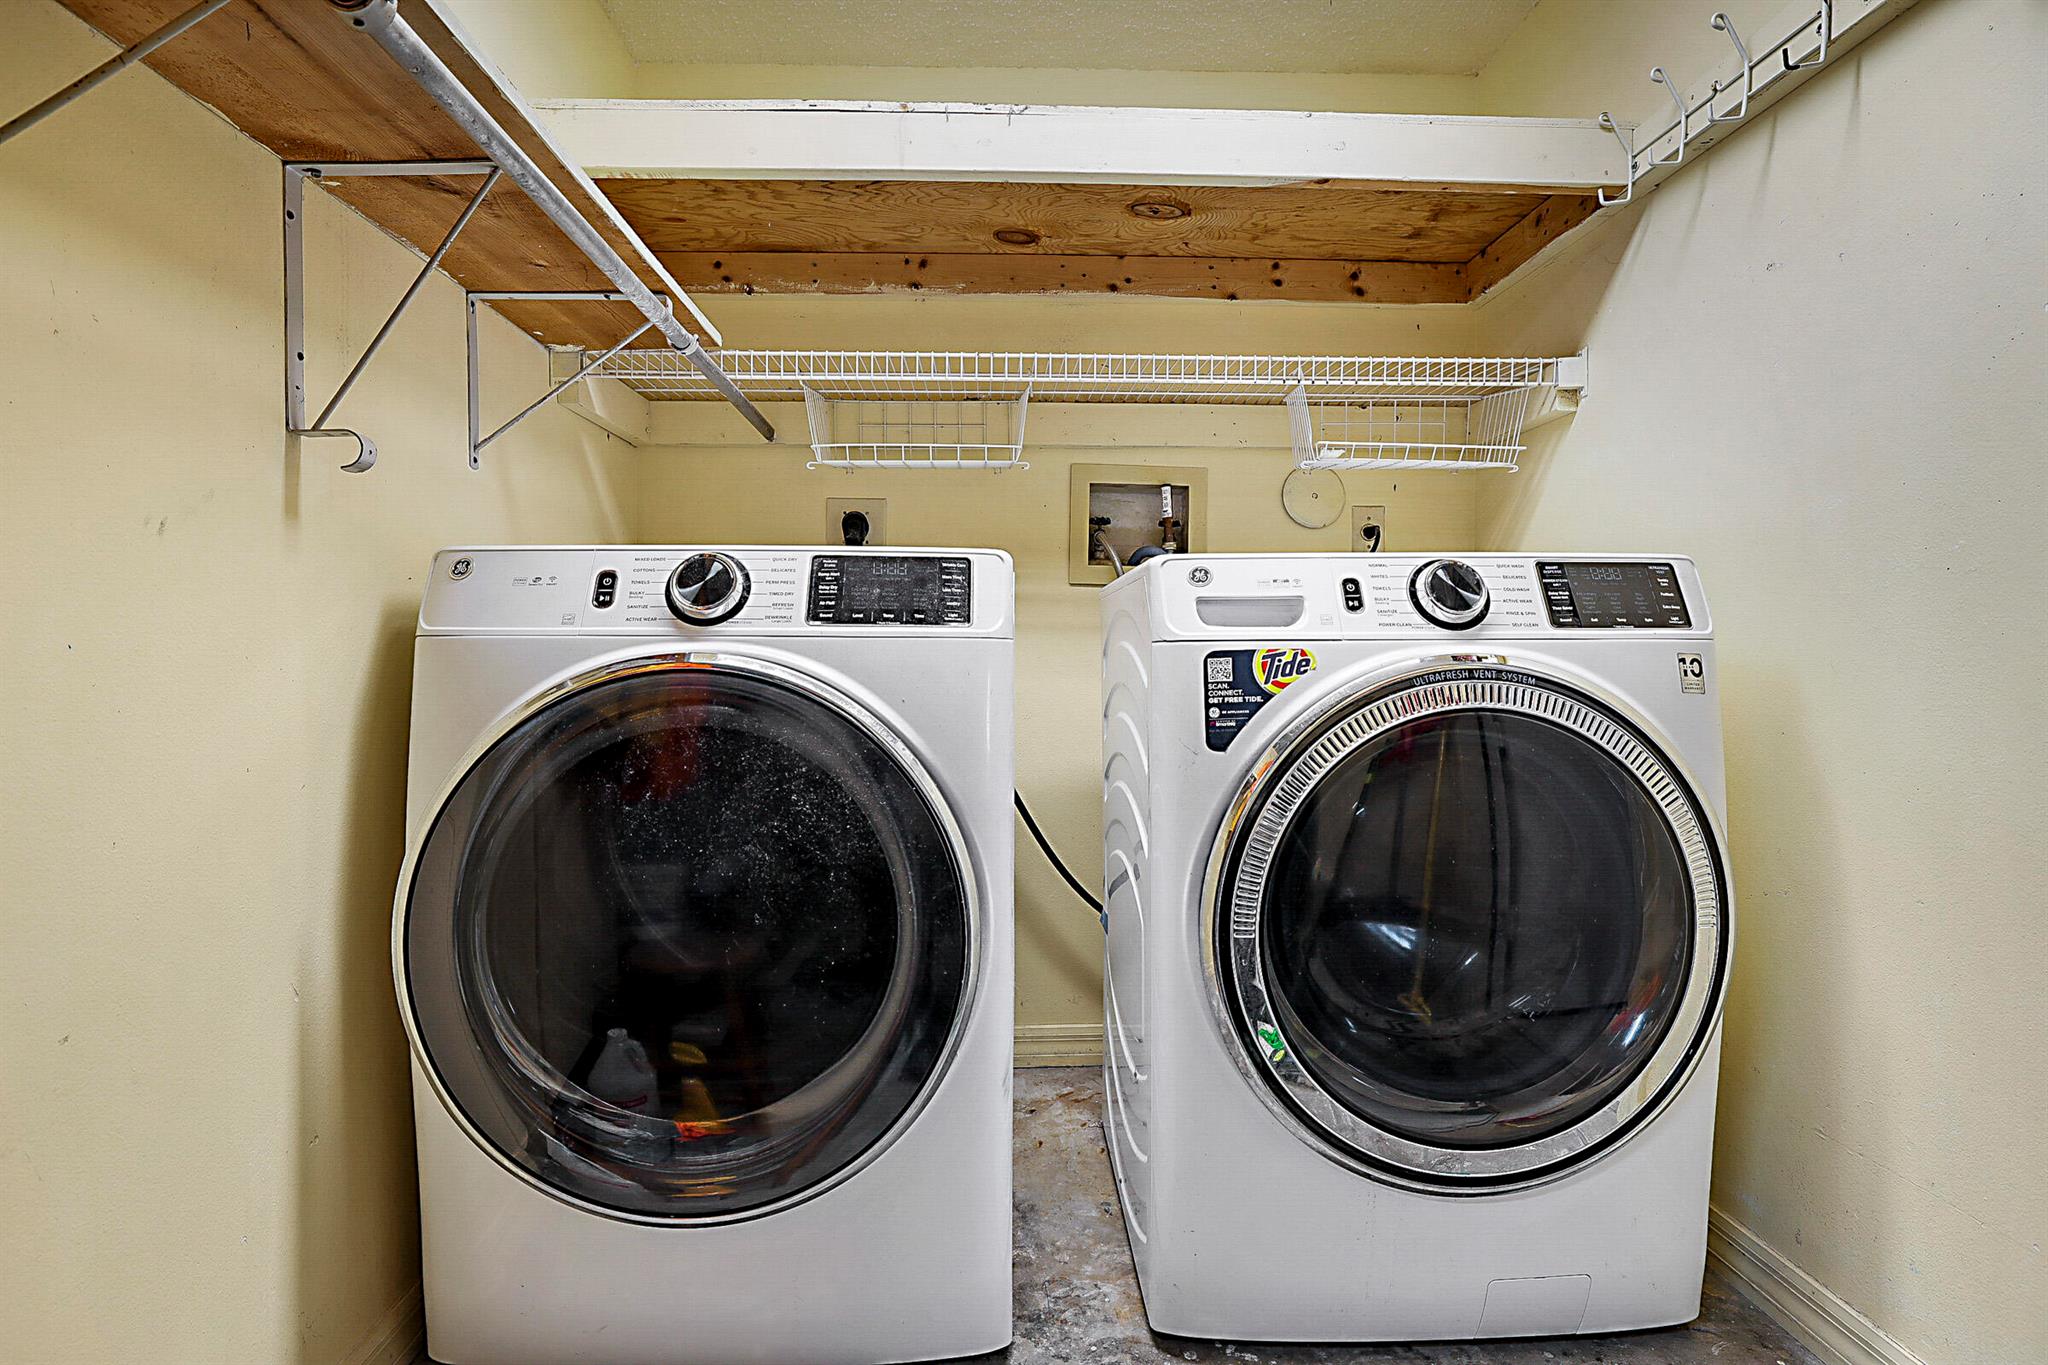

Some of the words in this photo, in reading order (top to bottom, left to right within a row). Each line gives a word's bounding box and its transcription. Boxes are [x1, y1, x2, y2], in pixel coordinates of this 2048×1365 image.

[1261, 650, 1311, 685] Tide
[1678, 657, 1704, 678] 10
[1208, 682, 1230, 690] SCAN.
[1412, 669, 1469, 686] ULTRAFRESH
[1473, 669, 1497, 679] VENT
[1501, 671, 1536, 685] SYSTEM
[1208, 689, 1244, 697] CONNECT.
